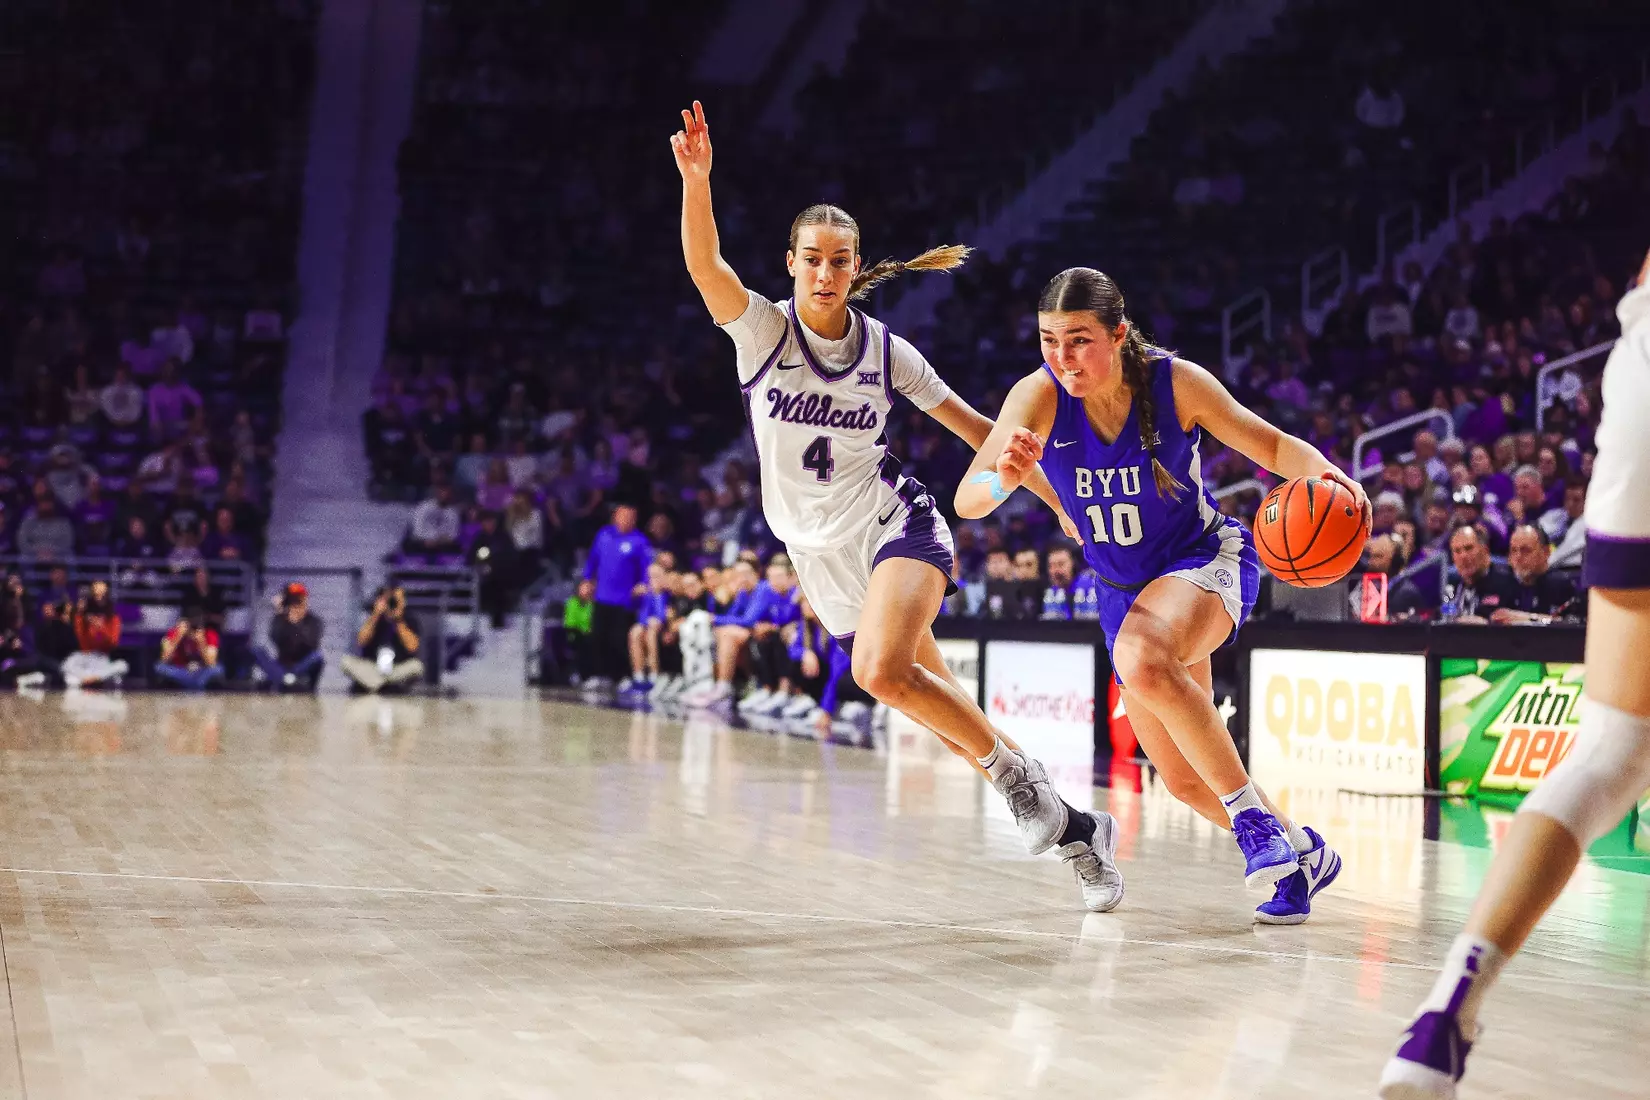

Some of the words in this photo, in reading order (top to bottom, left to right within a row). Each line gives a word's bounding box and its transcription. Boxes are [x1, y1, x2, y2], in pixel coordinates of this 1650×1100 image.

[856, 370, 881, 387] XII
[766, 387, 878, 431] Wildcats
[802, 435, 834, 482] 4
[1075, 465, 1141, 498] BYU
[1085, 503, 1144, 547] 10
[1265, 673, 1419, 759] QDOBA
[1502, 684, 1571, 726] Mtn
